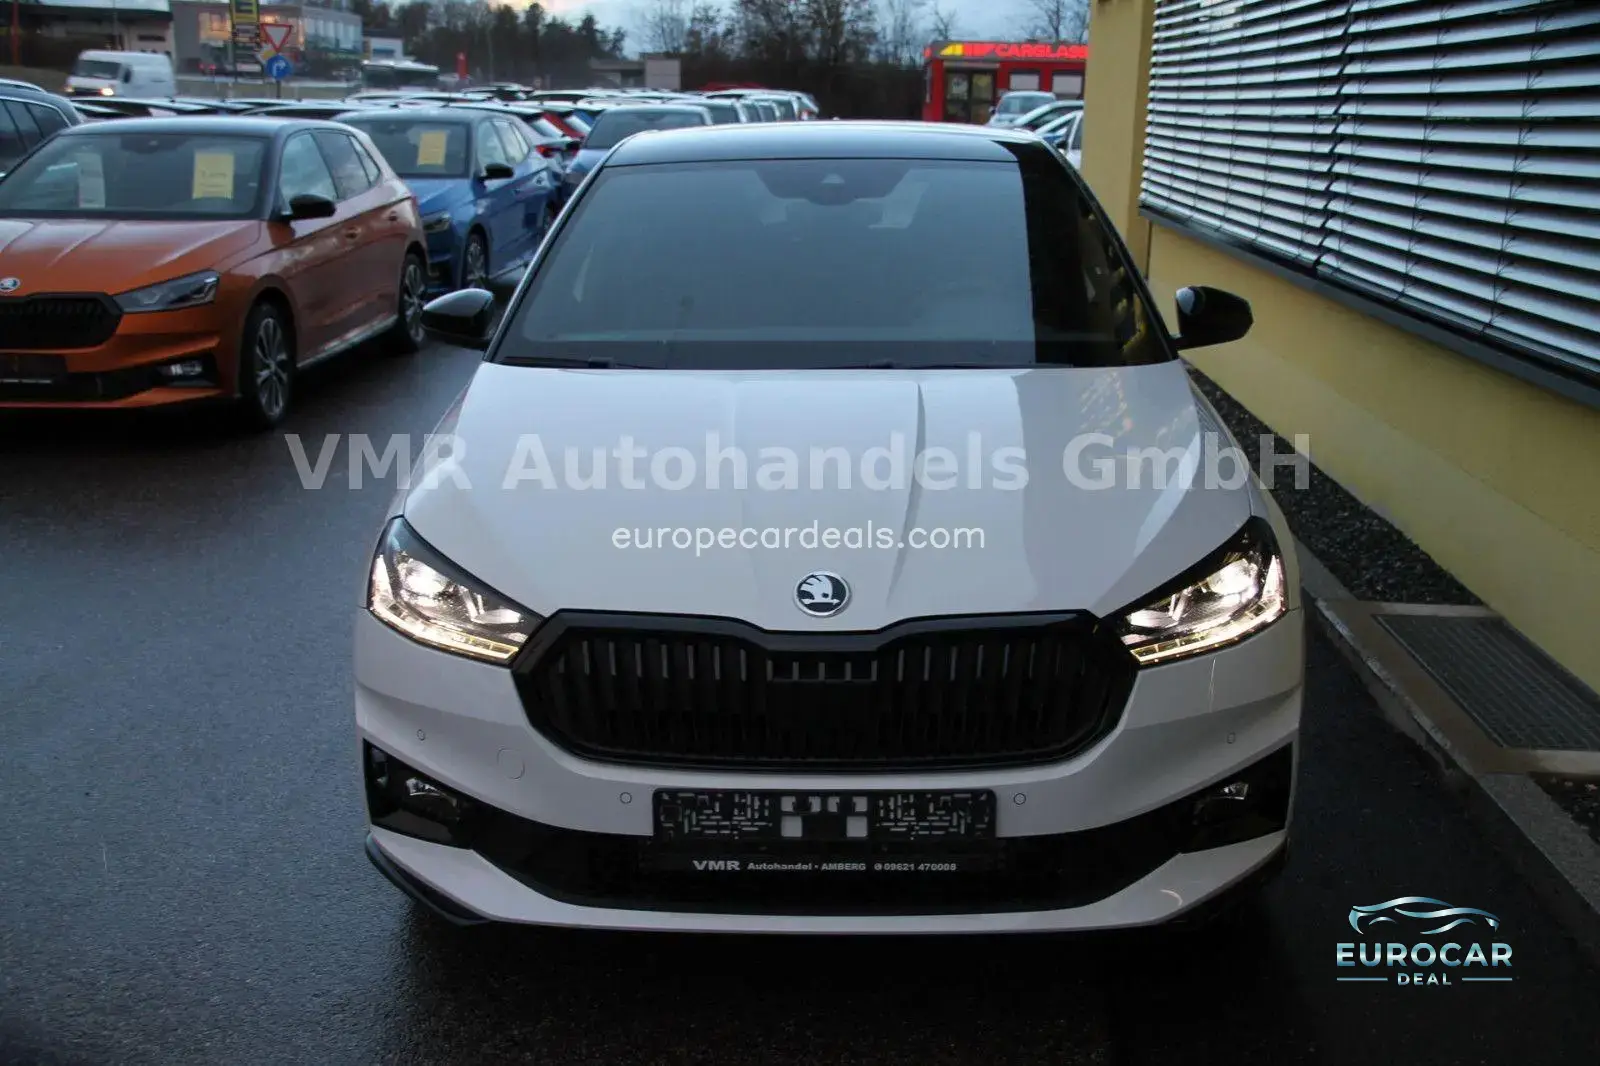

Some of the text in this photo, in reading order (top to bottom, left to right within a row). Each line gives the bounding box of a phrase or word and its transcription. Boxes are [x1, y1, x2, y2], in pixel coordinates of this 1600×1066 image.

[692, 860, 741, 871] VMR
[747, 862, 812, 870] Autohandel
[821, 862, 867, 871] AMBERG
